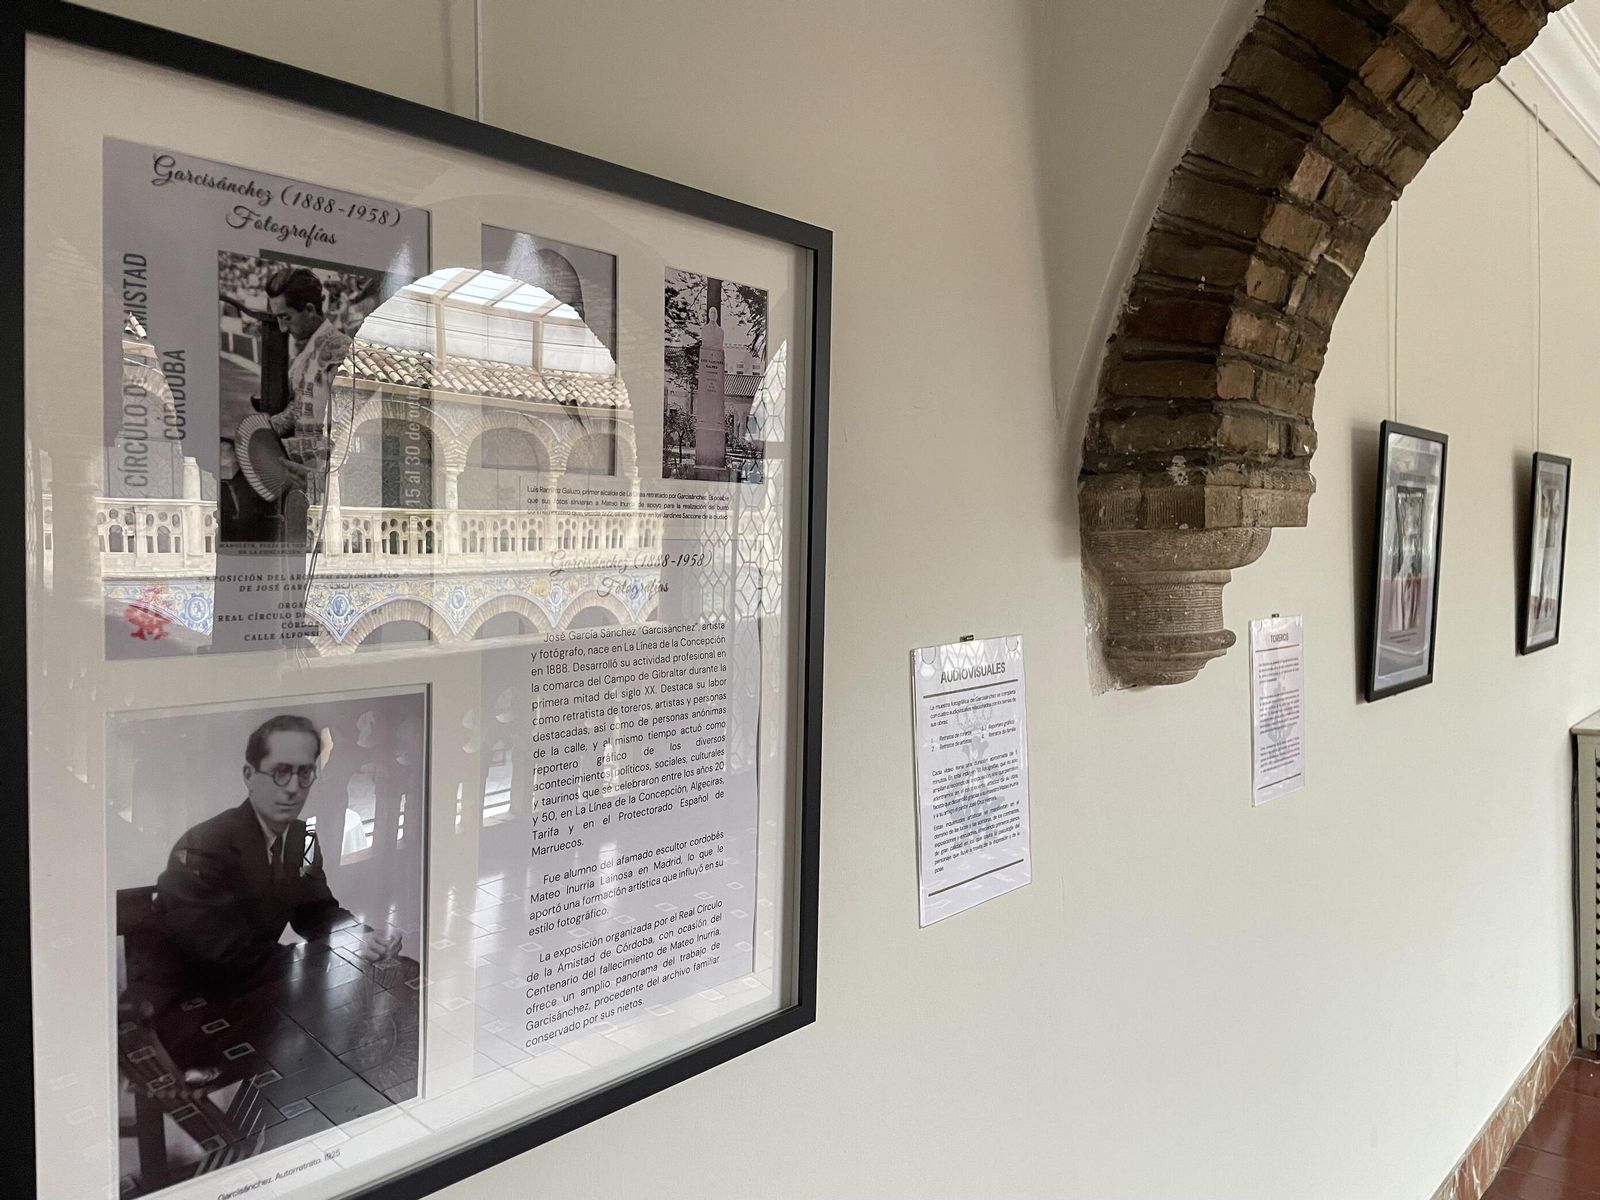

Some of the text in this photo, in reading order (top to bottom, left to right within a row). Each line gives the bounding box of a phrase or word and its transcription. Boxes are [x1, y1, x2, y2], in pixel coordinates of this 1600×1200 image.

[151, 153, 401, 228] Garcisánchez (1888-1958)
[225, 205, 337, 248] Fotografías
[405, 445, 420, 465] 30
[543, 630, 565, 642] José
[568, 629, 598, 640] García
[600, 627, 636, 638] Sánchez
[701, 620, 725, 630] artista
[530, 634, 725, 662] y fotógrafo, nace en La Línea de la Concepción
[531, 649, 726, 676] en 1888. Desarrolló su actividad profesional en
[531, 662, 726, 693] la comarca del Campo de Gibraltar durante la
[940, 662, 1006, 684] AUDIOVISUALES
[531, 697, 569, 712] primera
[573, 691, 599, 704] mitad
[603, 689, 617, 700] del
[621, 687, 641, 699] siglo
[660, 682, 693, 693] Destaca
[696, 681, 705, 689] su
[708, 677, 726, 687] labor
[532, 693, 726, 726] como retratista de toreros, artistas y personas
[532, 706, 726, 742] destacadas, así como de personas anónimas
[690, 748, 724, 761] culturales
[531, 839, 583, 857] Marruecos.
[543, 830, 724, 885] Fue alumno del afamado escultor cordobés
[530, 889, 560, 904] Mateo
[566, 879, 594, 894] Inurria
[638, 866, 648, 875] en
[687, 852, 694, 862] lo
[698, 848, 713, 860] que
[528, 921, 554, 937] estilo
[539, 899, 722, 963] La exposición organizada por el Real Círculo
[526, 974, 578, 999] Centenario
[581, 967, 596, 980] del
[599, 949, 654, 974] fallecimiento
[656, 945, 667, 956] de
[670, 937, 694, 951] Mateo
[594, 982, 644, 1009] procedente
[646, 975, 659, 988] del
[662, 966, 690, 983] archivo
[525, 1021, 580, 1048] conservado
[582, 1015, 598, 1029] por
[600, 1008, 615, 1020] sus
[324, 1149, 340, 1161] 1925
